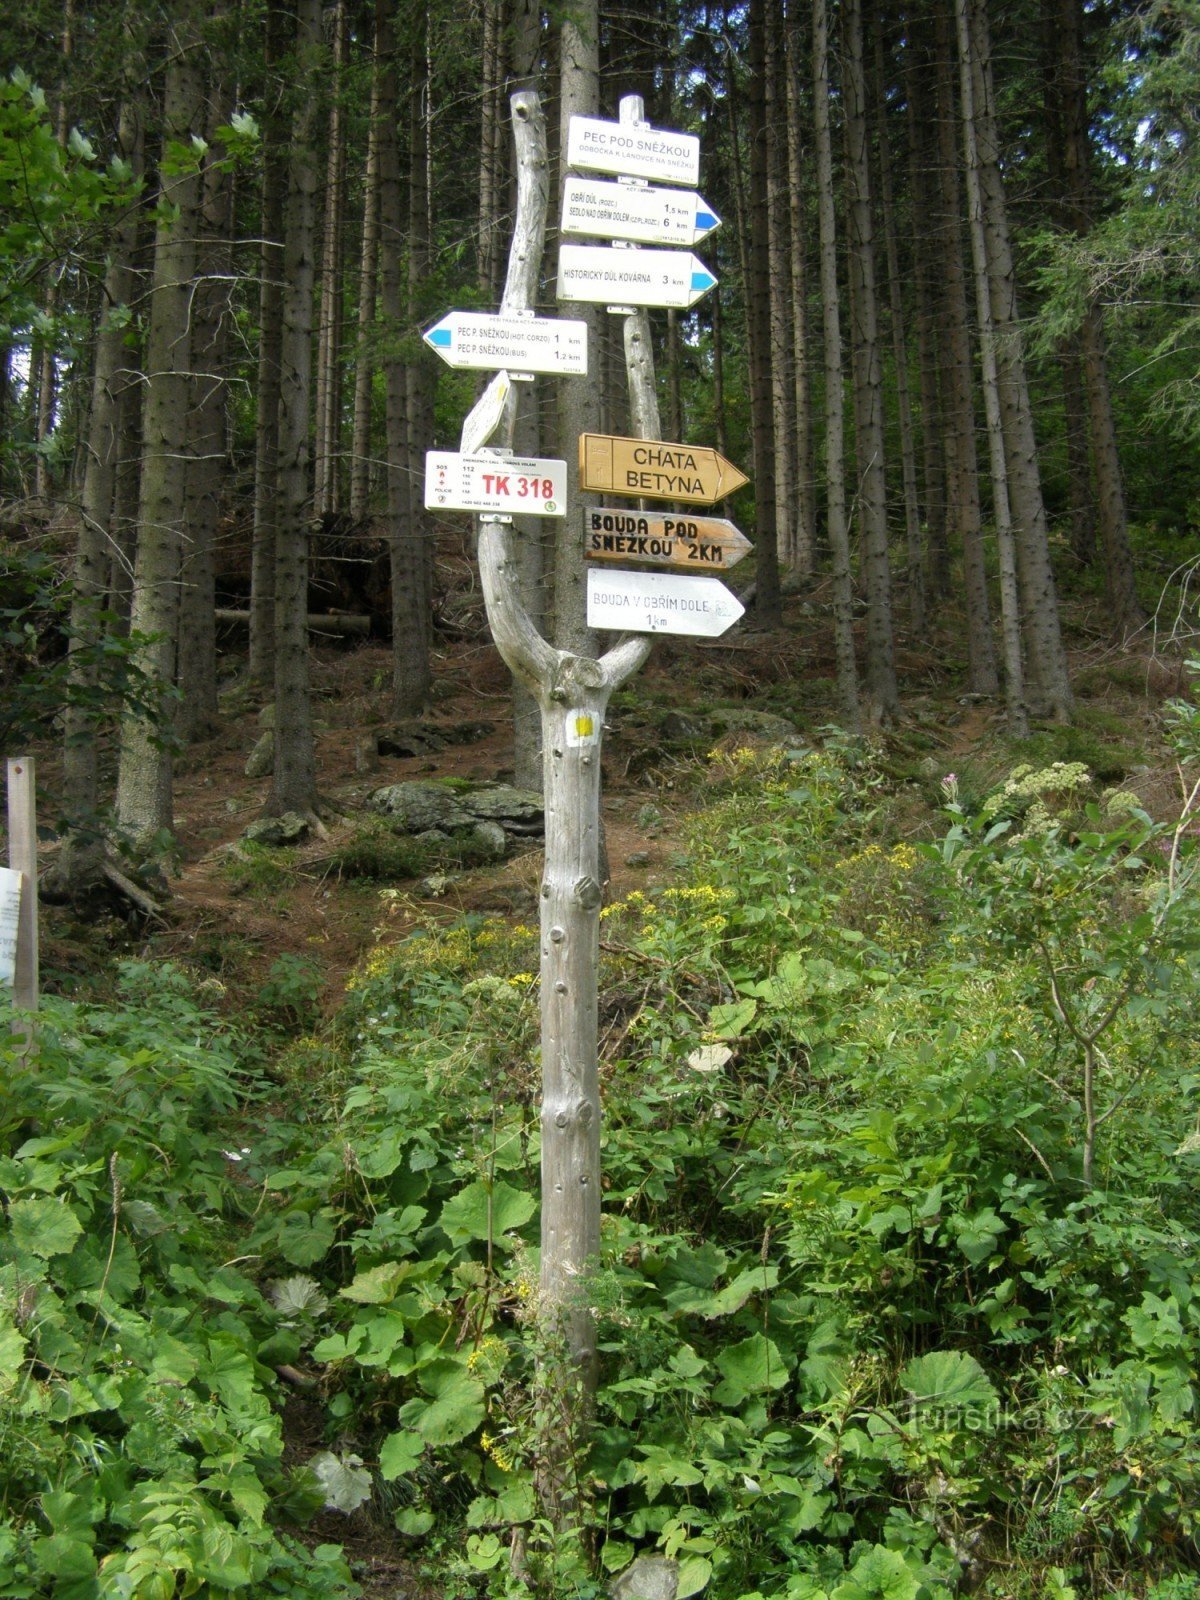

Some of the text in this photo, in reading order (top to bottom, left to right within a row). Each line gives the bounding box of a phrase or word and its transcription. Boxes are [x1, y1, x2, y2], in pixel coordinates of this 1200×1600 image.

[584, 131, 690, 158] PEC POD SNĚŽKOU
[569, 206, 586, 216] SEDLO
[586, 209, 596, 218] NAD
[612, 213, 630, 222] DOLEM
[664, 218, 670, 226] 6
[676, 222, 688, 230] km
[564, 268, 684, 286] HISTORICKÝ DŮL KOVÁRNA 3 km
[458, 326, 471, 336] PEC
[472, 328, 478, 338] P.
[479, 327, 510, 340] SNĚŽKOU
[526, 334, 550, 344] CORZO)
[554, 334, 560, 343] 1
[458, 344, 471, 353] PEC
[472, 345, 478, 354] P.
[633, 448, 698, 471] CHATA
[482, 474, 554, 499] TK 318
[626, 470, 705, 495] BETYNA
[591, 513, 698, 539] BOUDA POD
[593, 592, 709, 612] BOUDA V OBŘÍM DOLE
